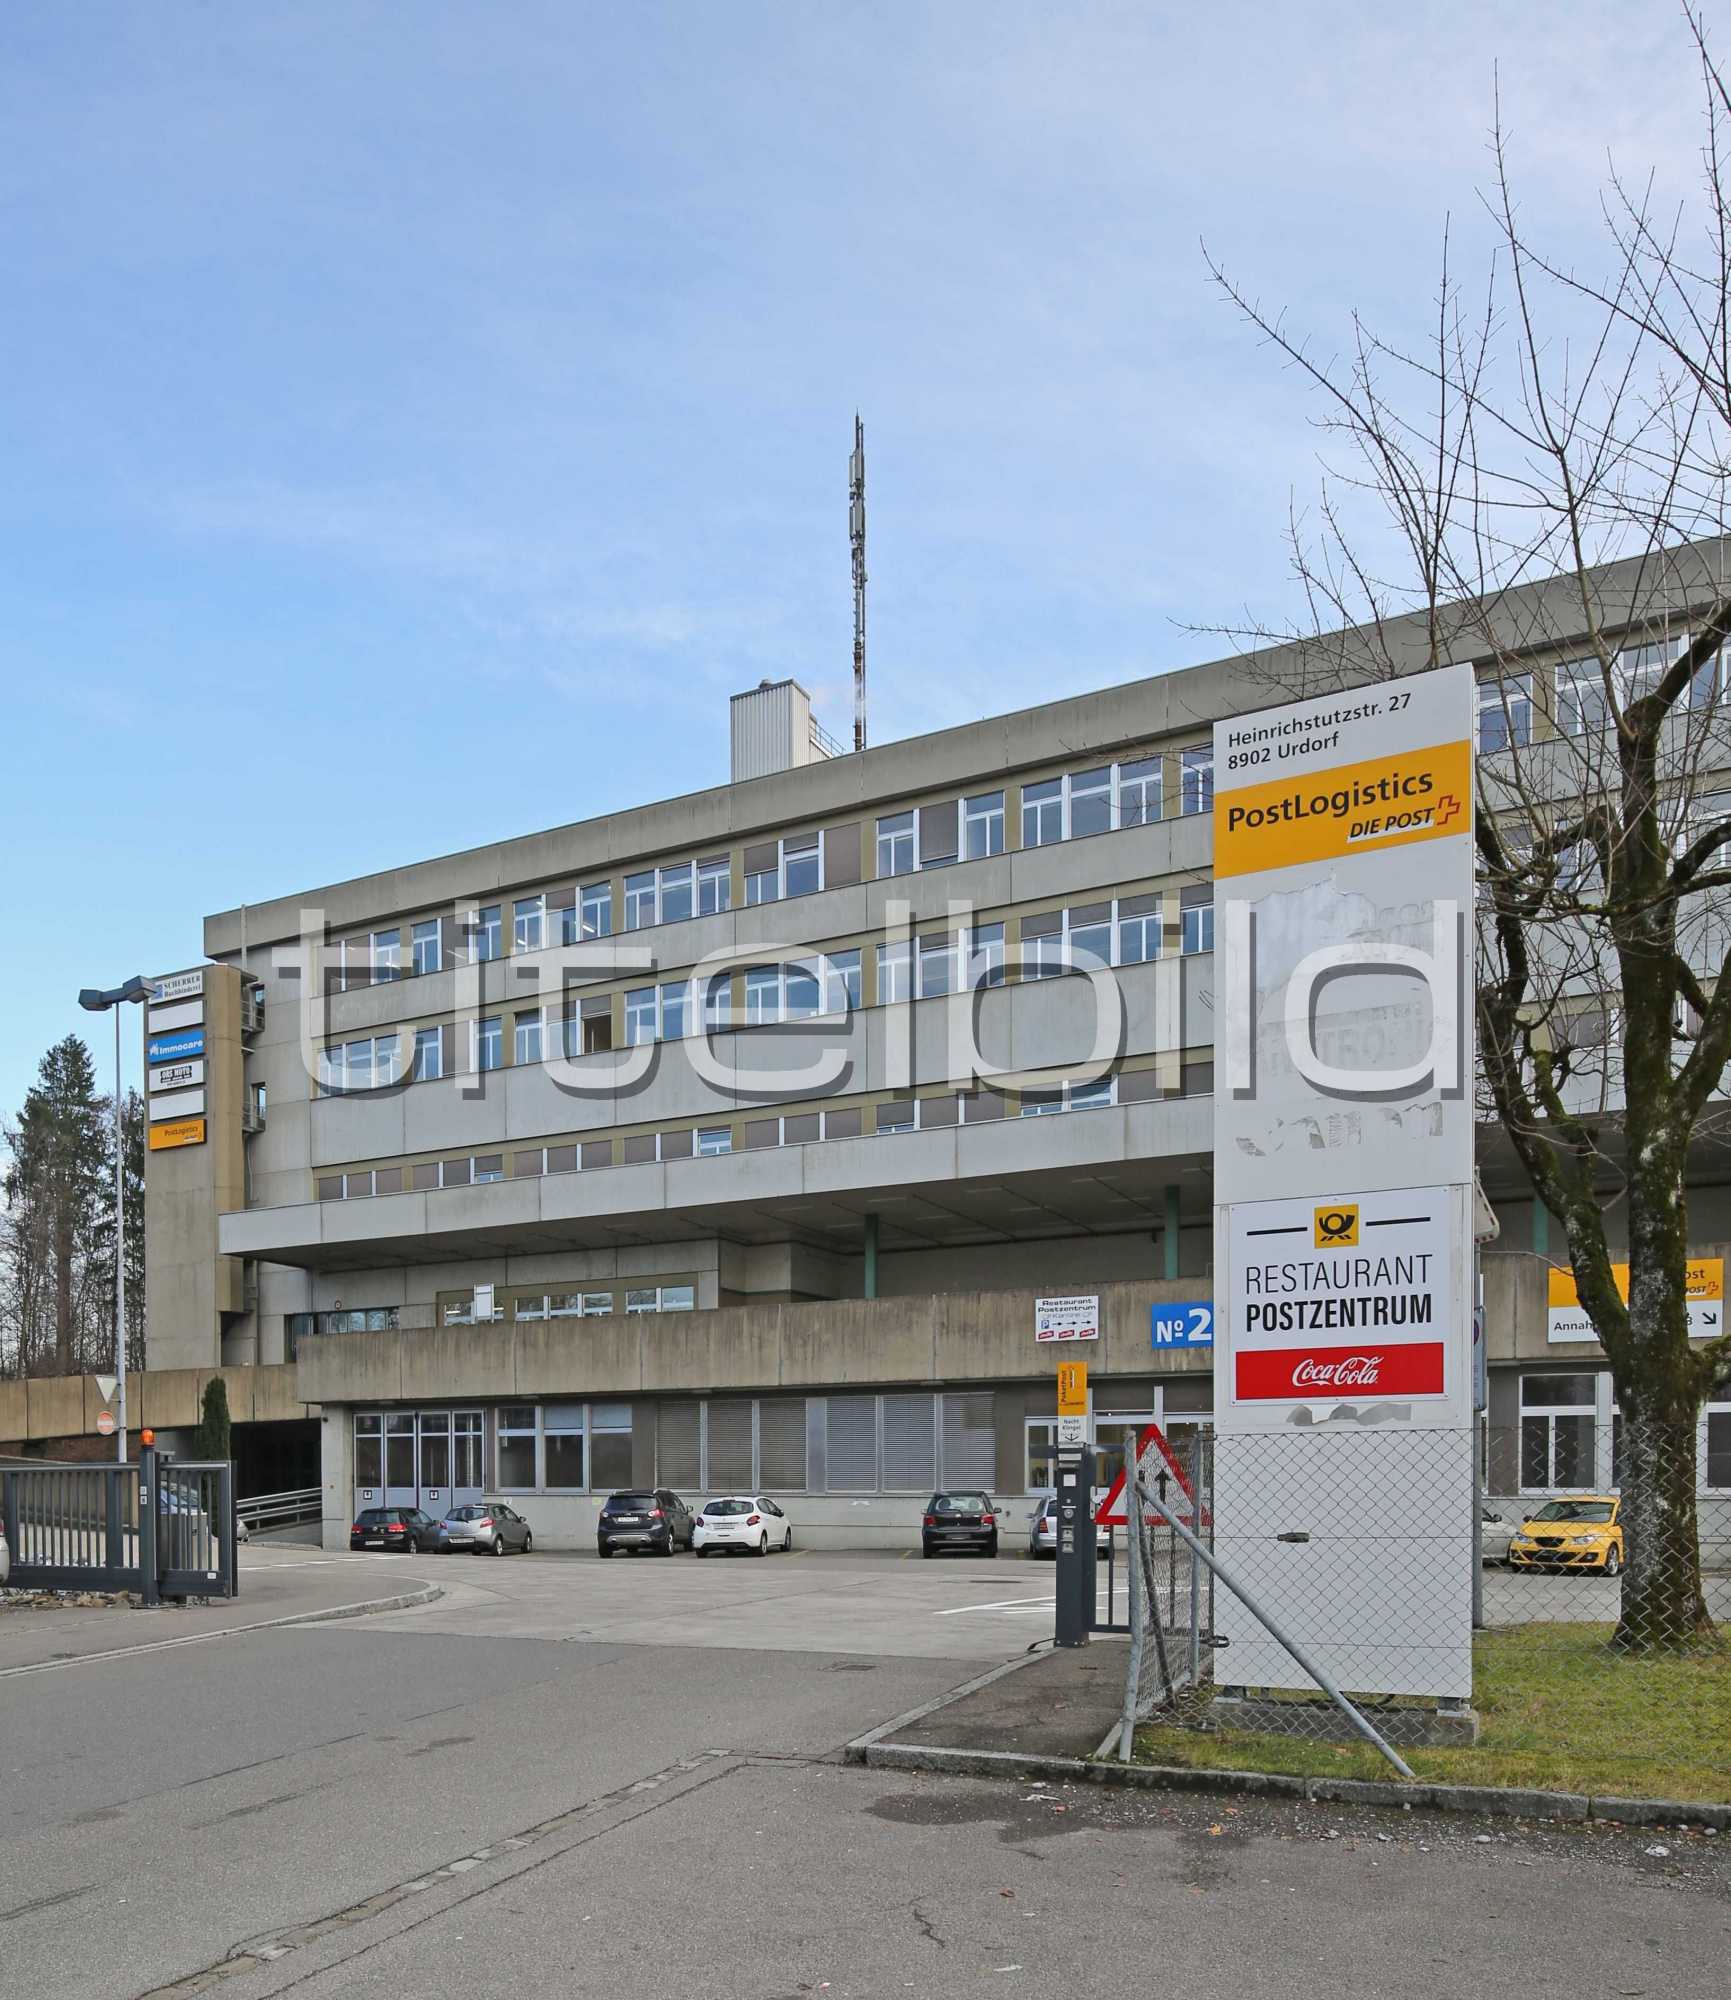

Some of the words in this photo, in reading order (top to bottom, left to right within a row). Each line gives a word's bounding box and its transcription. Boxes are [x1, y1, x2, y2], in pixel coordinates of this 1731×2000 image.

[1228, 702, 1382, 748] Heinrichstutzstr.
[1388, 693, 1412, 712] 27
[1227, 748, 1271, 770] 8902
[1278, 731, 1340, 760] Urdorf
[1228, 772, 1433, 832] PostLogistics
[1350, 818, 1380, 838] DIE
[1385, 807, 1435, 831] POST
[1246, 1253, 1433, 1295] RESTAURANT
[1042, 1298, 1093, 1306] Restaurant
[1246, 1294, 1432, 1332] POSTZENTRUM
[1188, 1308, 1212, 1341] 2
[1554, 1320, 1593, 1331] Annah
[1292, 1356, 1384, 1387] Coca-Cola
